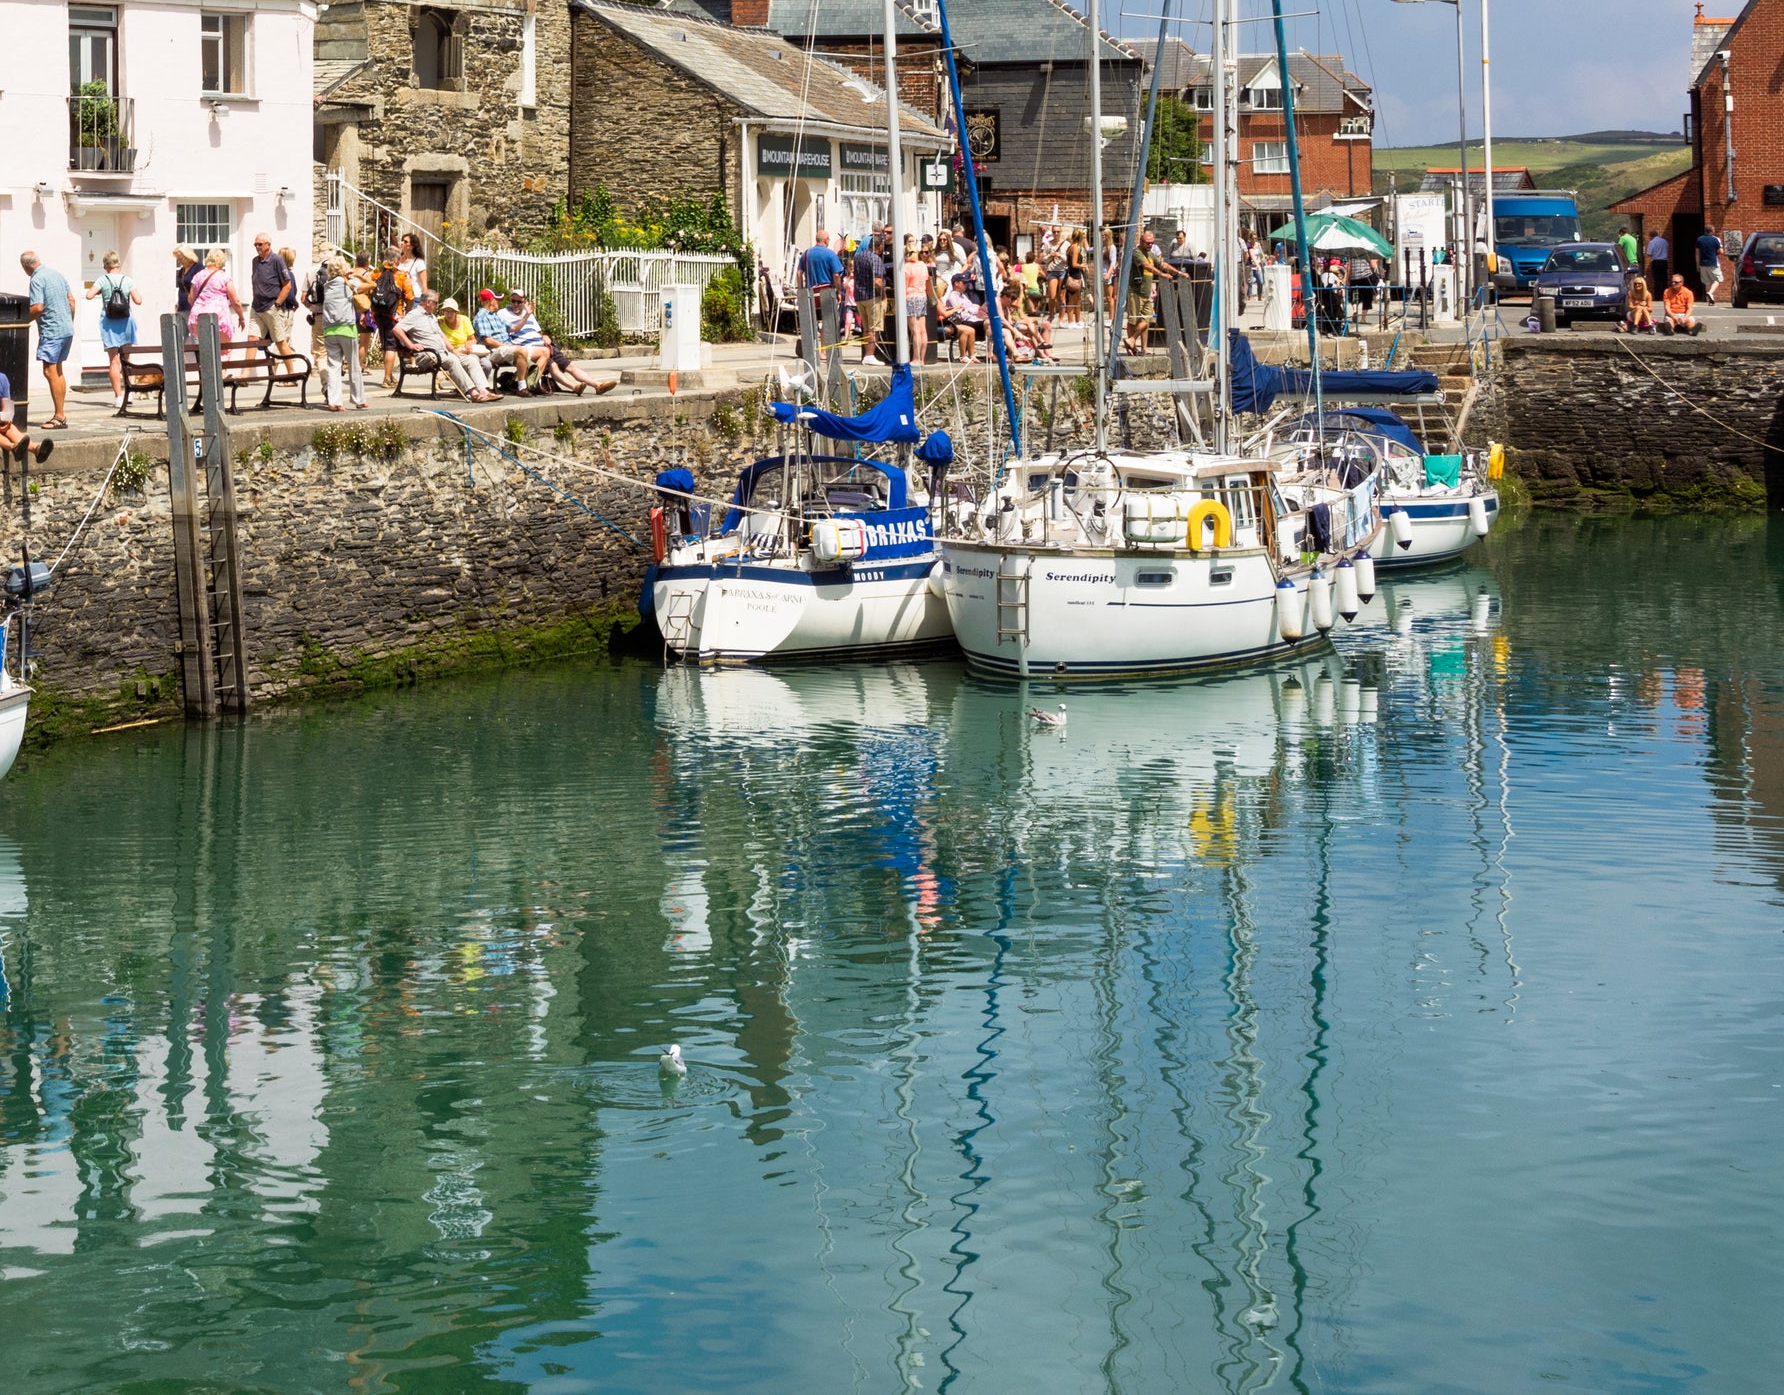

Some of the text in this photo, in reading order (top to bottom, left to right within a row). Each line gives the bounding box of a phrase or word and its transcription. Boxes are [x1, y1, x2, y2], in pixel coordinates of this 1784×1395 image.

[766, 150, 795, 164] MOUNTAIN
[195, 440, 202, 456] 5
[866, 519, 927, 547] BRAXAS
[853, 571, 884, 581] MOODY
[957, 565, 995, 579] Serendipity
[1046, 572, 1117, 584] Serendipity
[747, 603, 776, 613] POOLE
